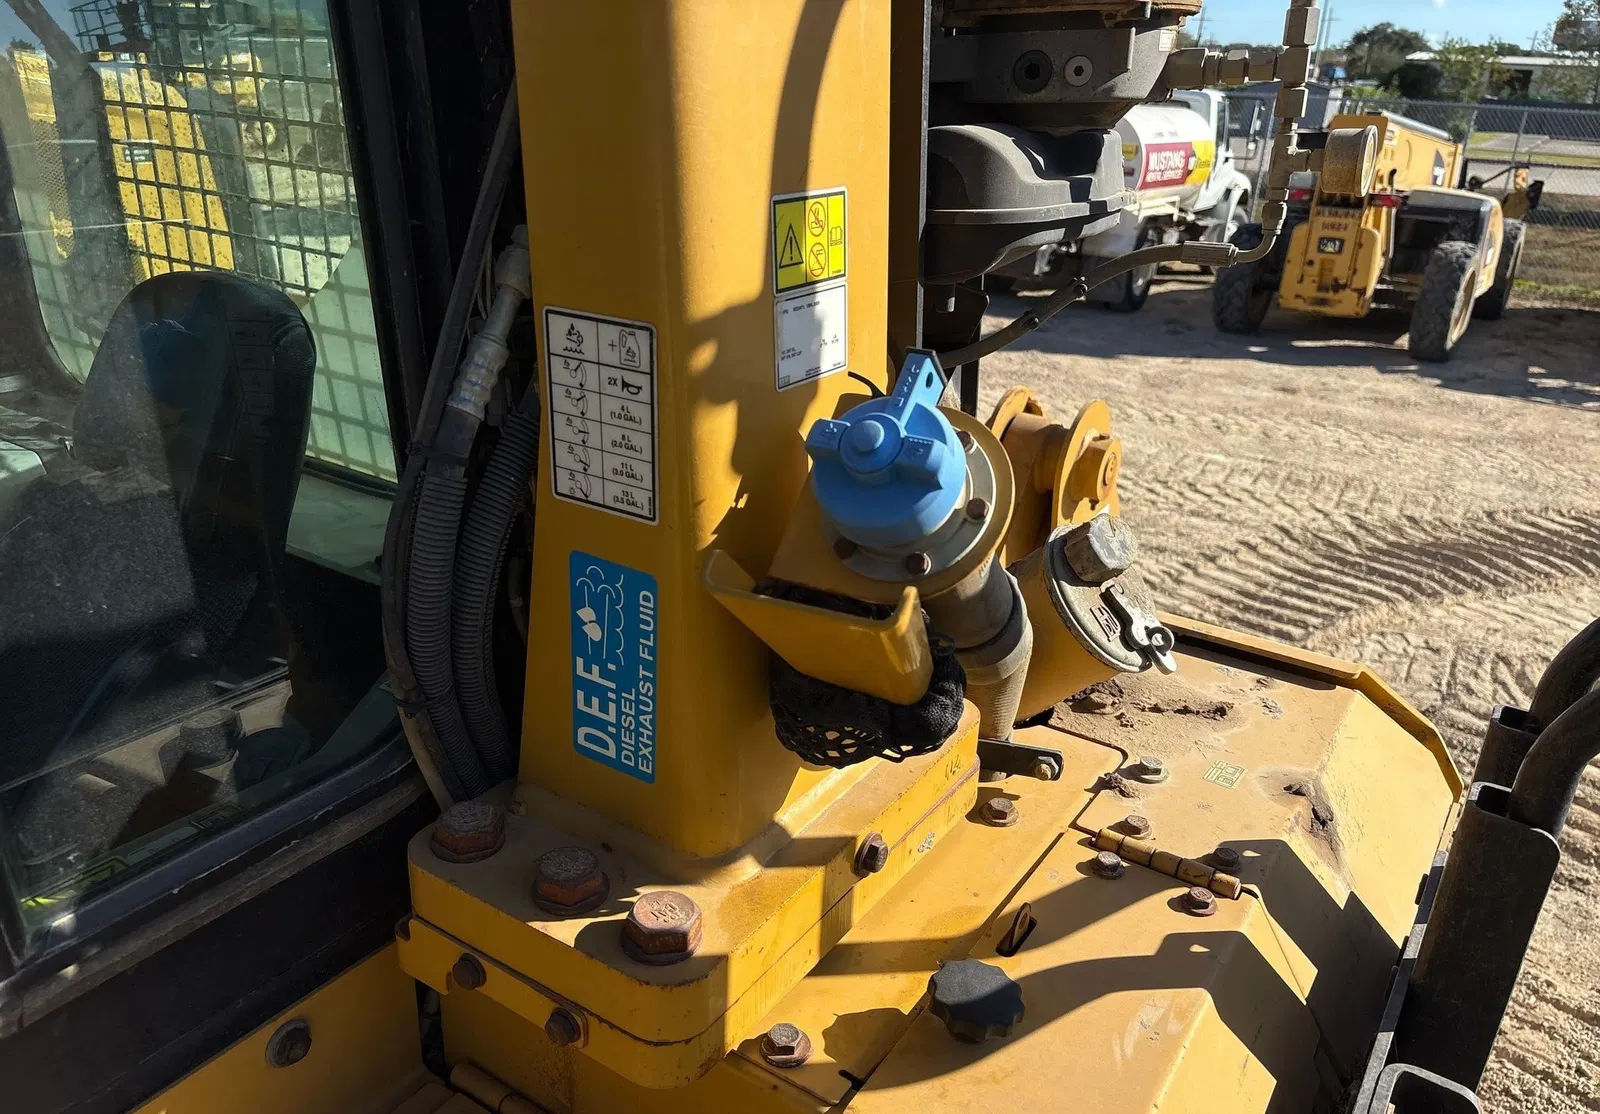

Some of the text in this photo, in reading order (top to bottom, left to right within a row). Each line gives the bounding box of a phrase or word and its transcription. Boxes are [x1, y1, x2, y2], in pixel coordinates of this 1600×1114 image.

[1149, 150, 1185, 171] MUSTANG
[607, 377, 618, 387] 2X
[610, 411, 642, 426] (1.0 GAL.)
[611, 439, 643, 455] (2.0 GAL.)
[620, 462, 628, 470] 11
[612, 468, 644, 483] (3.0 GAL.)
[621, 490, 629, 498] 13
[613, 496, 625, 505] (3.5
[626, 499, 644, 511] GAL.)
[638, 590, 655, 775] EXHAUST FLUID
[576, 655, 617, 760] D.E.F.
[621, 687, 636, 768] DIESEL
